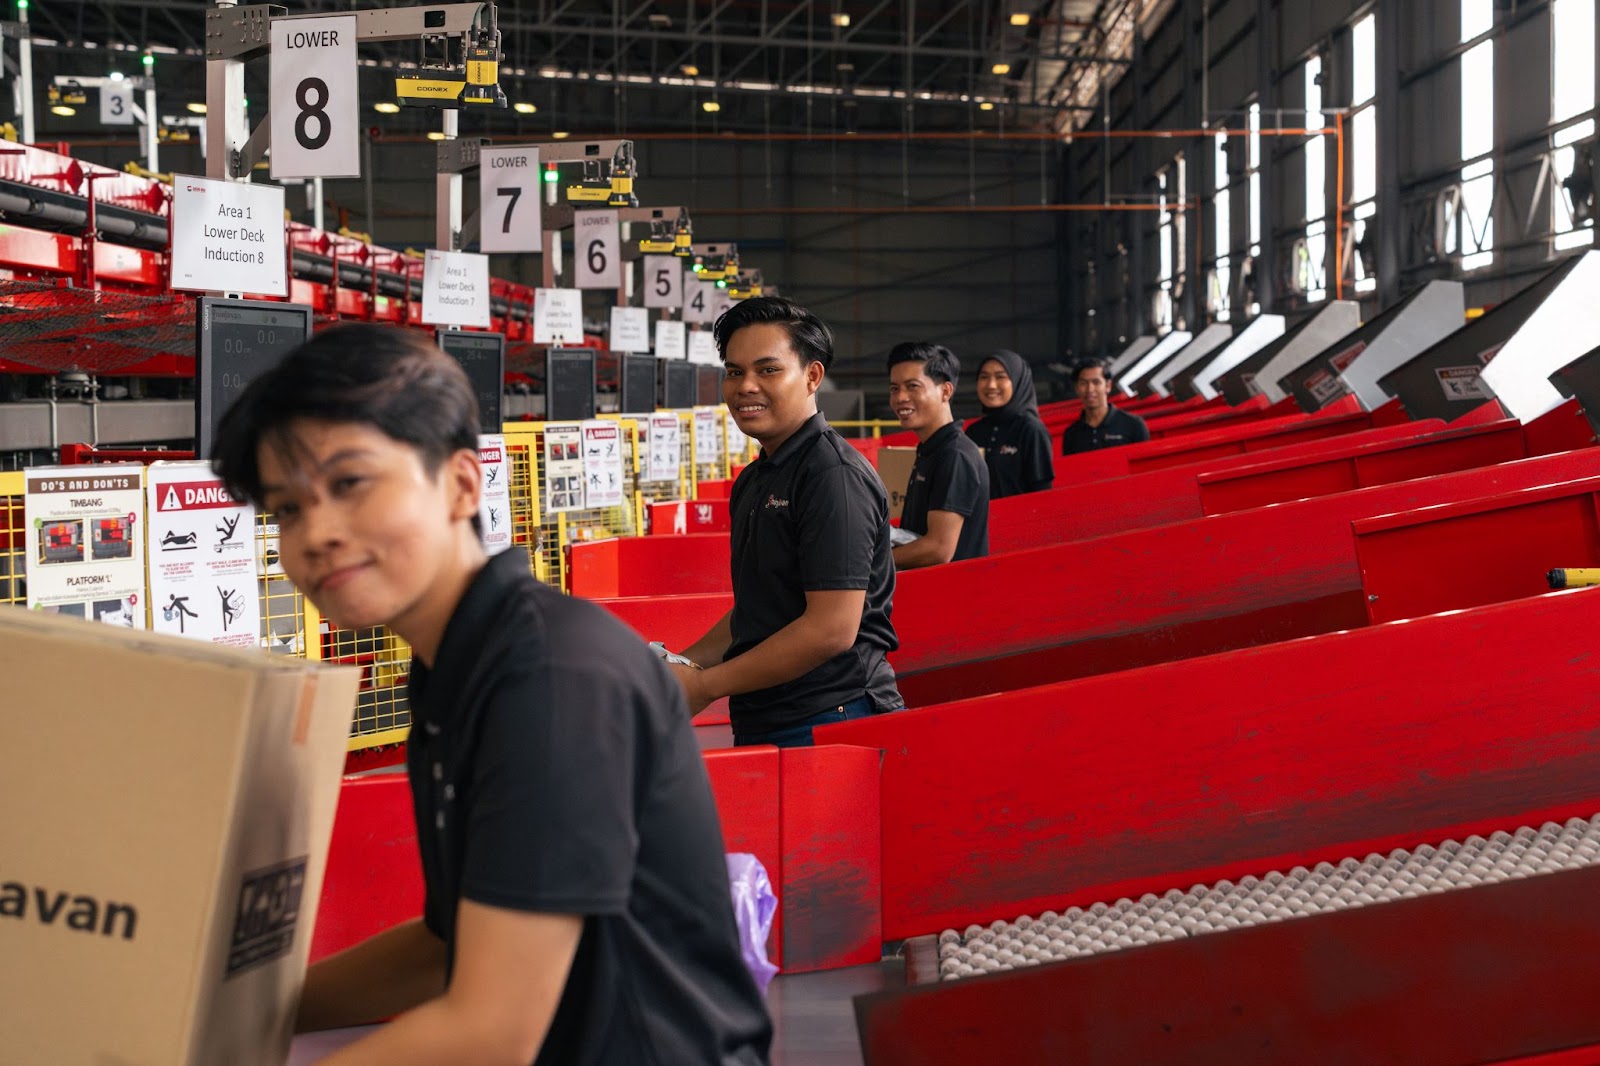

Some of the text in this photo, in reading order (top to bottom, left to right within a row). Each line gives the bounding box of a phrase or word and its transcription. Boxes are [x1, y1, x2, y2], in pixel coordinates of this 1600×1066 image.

[287, 30, 339, 48] LOWER
[111, 95, 123, 116] 3
[294, 76, 331, 150] 8
[491, 156, 528, 168] LOWER
[218, 204, 252, 219] Area 1
[497, 187, 521, 233] 7
[582, 216, 610, 226] LOWER
[204, 224, 264, 242] Lower Deck
[205, 246, 264, 264] Induction 8
[588, 240, 606, 274] 6
[447, 267, 461, 276] Area
[439, 281, 475, 291] Lower Deck
[656, 270, 671, 296] 5
[439, 295, 469, 305] Induction
[691, 289, 705, 313] 4
[258, 330, 275, 344] 0.0
[225, 339, 242, 353] 0.0
[223, 373, 240, 388] 0.0
[41, 479, 129, 491] DO'S AND DON'TS
[70, 498, 102, 507] TIMBANG
[66, 575, 104, 586] PLATFORM
[0, 882, 138, 941] avan
